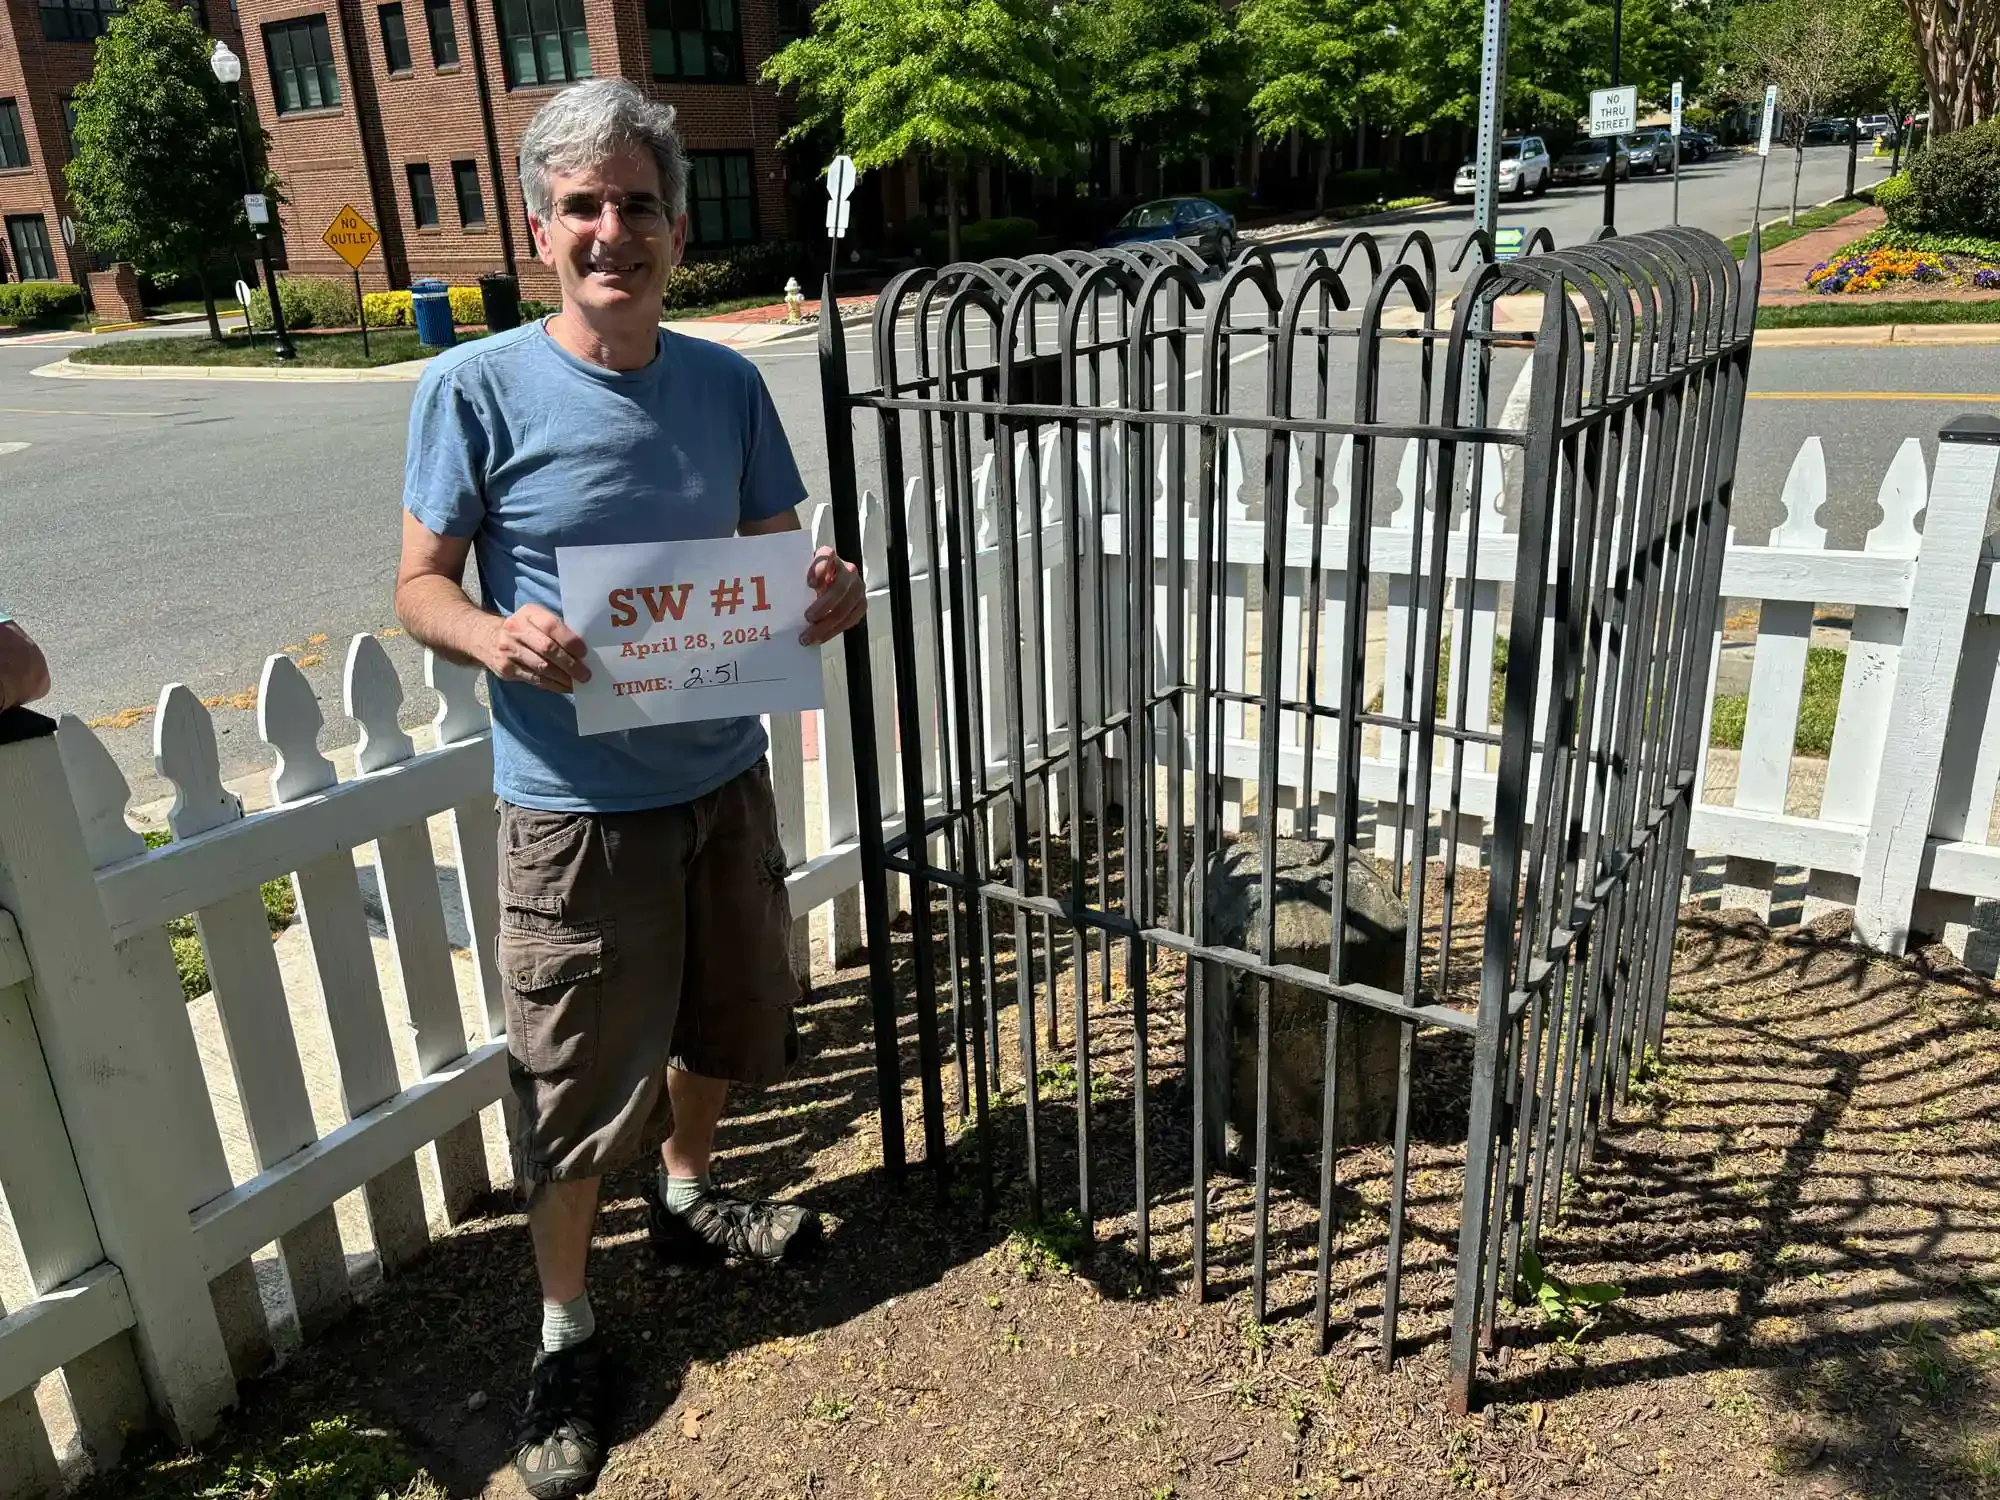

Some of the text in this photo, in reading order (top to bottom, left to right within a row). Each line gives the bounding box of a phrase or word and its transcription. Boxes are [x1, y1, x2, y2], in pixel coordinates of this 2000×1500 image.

[1606, 94, 1620, 104] NO
[1600, 105, 1626, 117] THRU
[1595, 118, 1629, 131] STREET
[341, 218, 357, 229] NO
[330, 232, 372, 245] OUTLET
[608, 575, 771, 628] SW #1
[619, 625, 771, 660] April 28, 2024
[612, 660, 739, 697] TIME: 2:51
